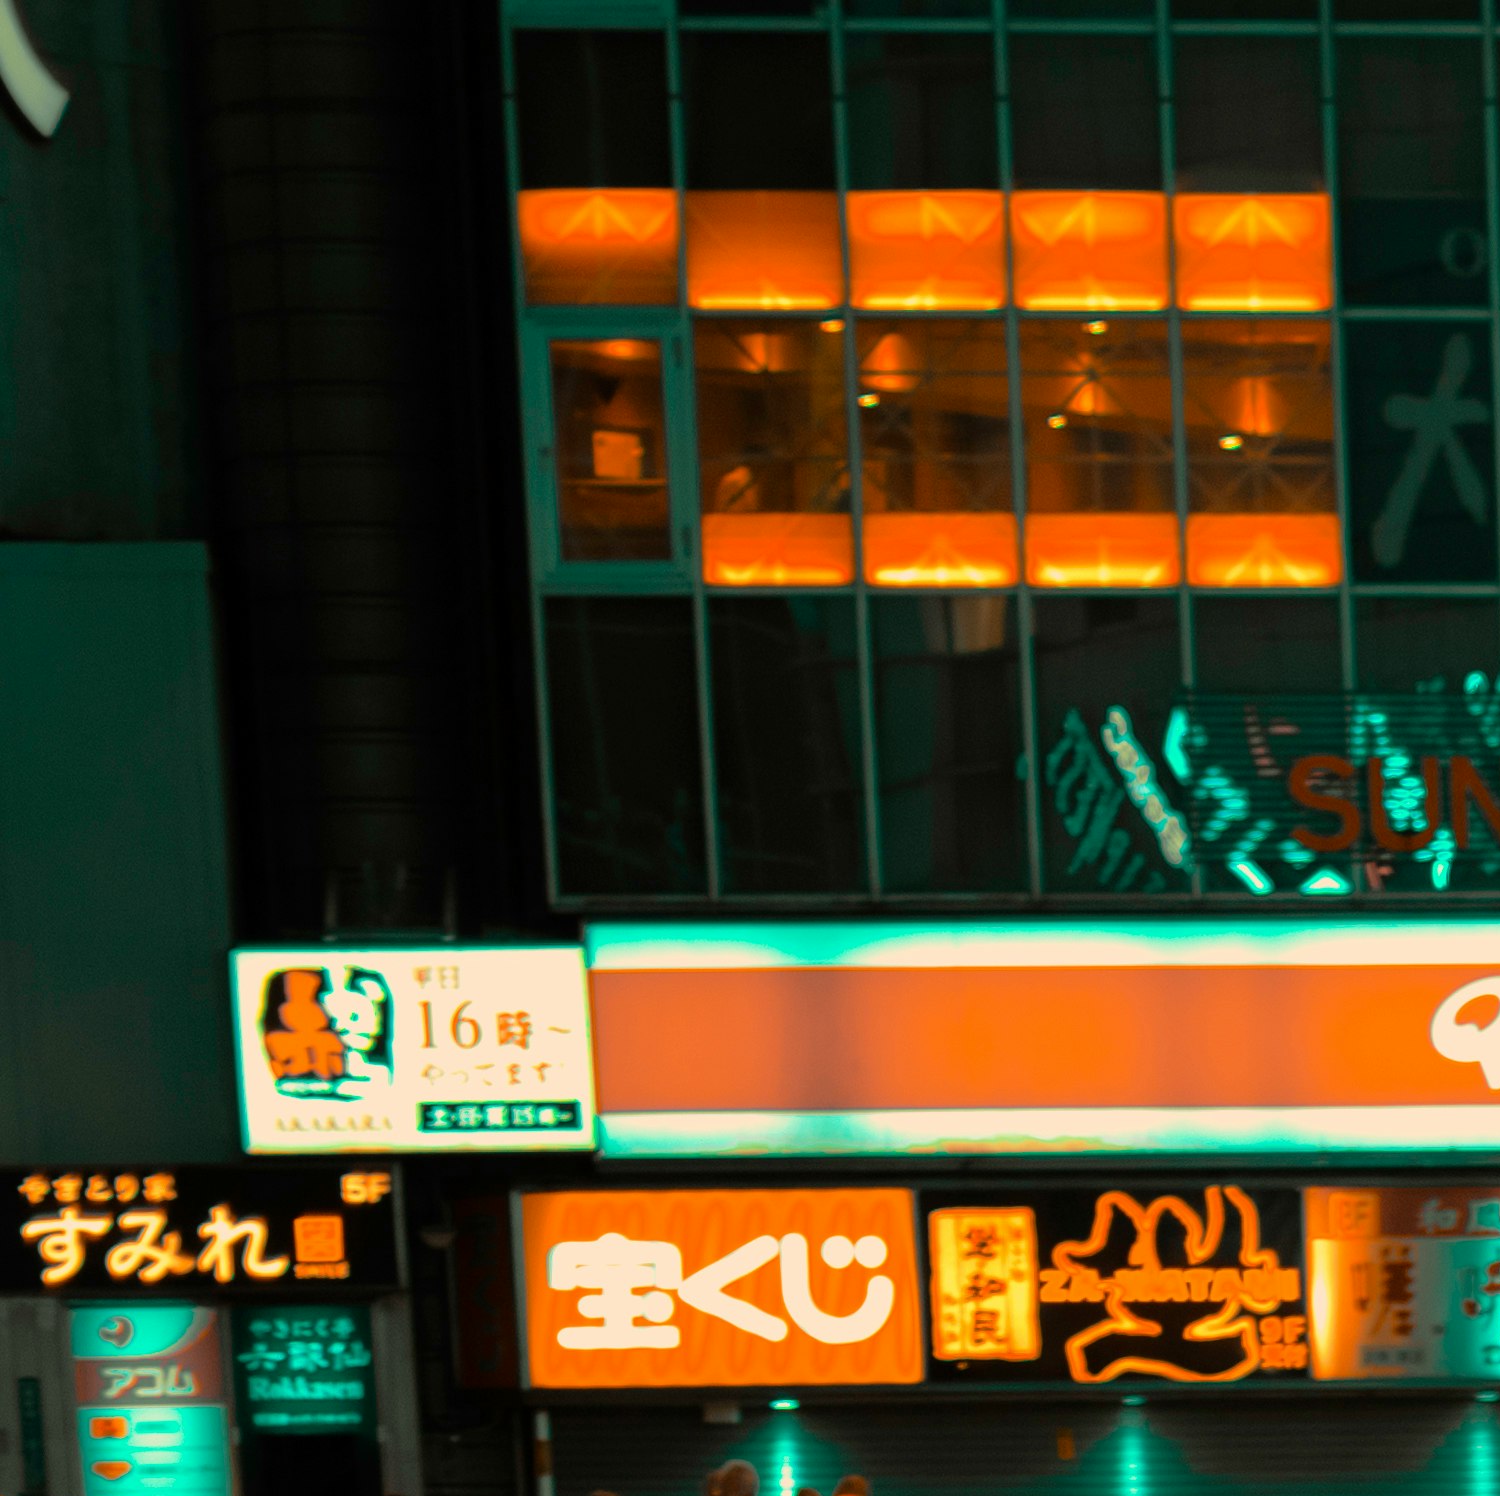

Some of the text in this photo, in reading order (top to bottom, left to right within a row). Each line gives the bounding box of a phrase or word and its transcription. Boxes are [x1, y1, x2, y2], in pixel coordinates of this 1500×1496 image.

[20, 1203, 290, 1286] すみれ
[548, 1232, 896, 1352] 宝くじ
[102, 1364, 197, 1399] アコム
